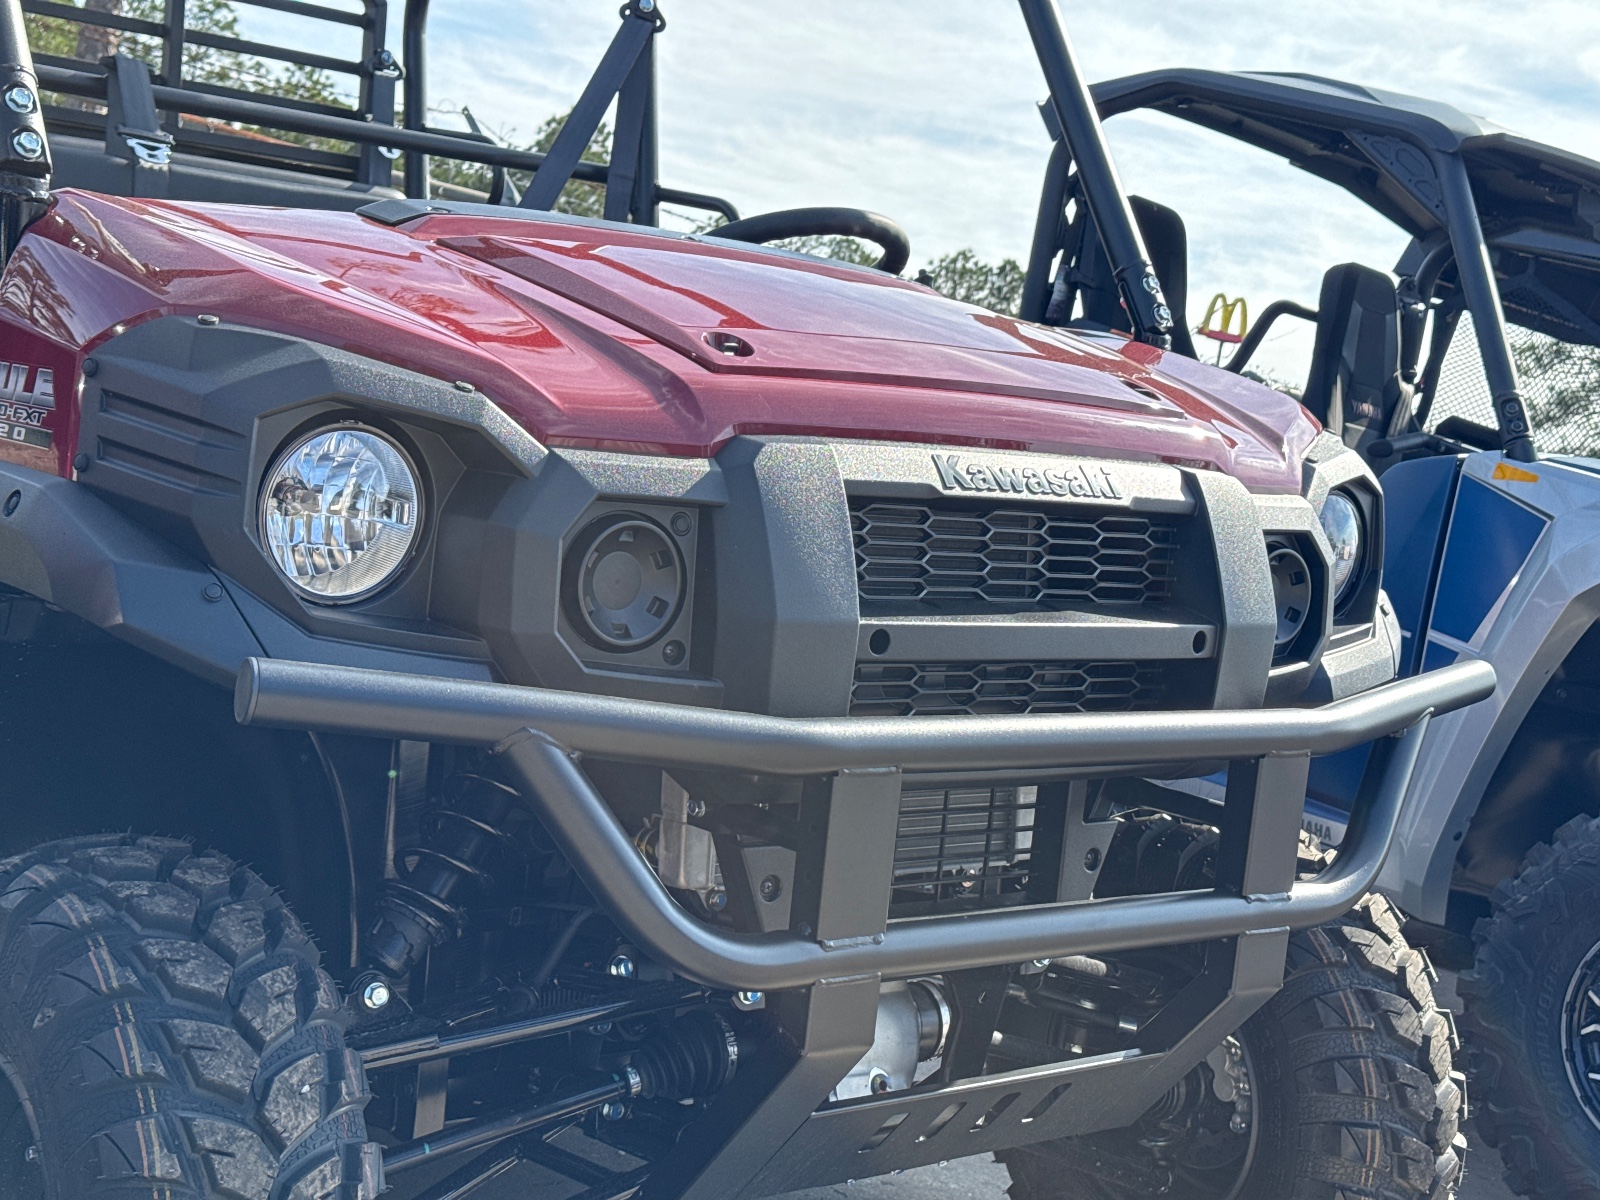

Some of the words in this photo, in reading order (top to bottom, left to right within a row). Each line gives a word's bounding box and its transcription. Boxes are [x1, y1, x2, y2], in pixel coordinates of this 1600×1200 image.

[0, 361, 55, 410] ULE
[931, 454, 1123, 499] Kawasaki
[1301, 818, 1332, 842] AHA
